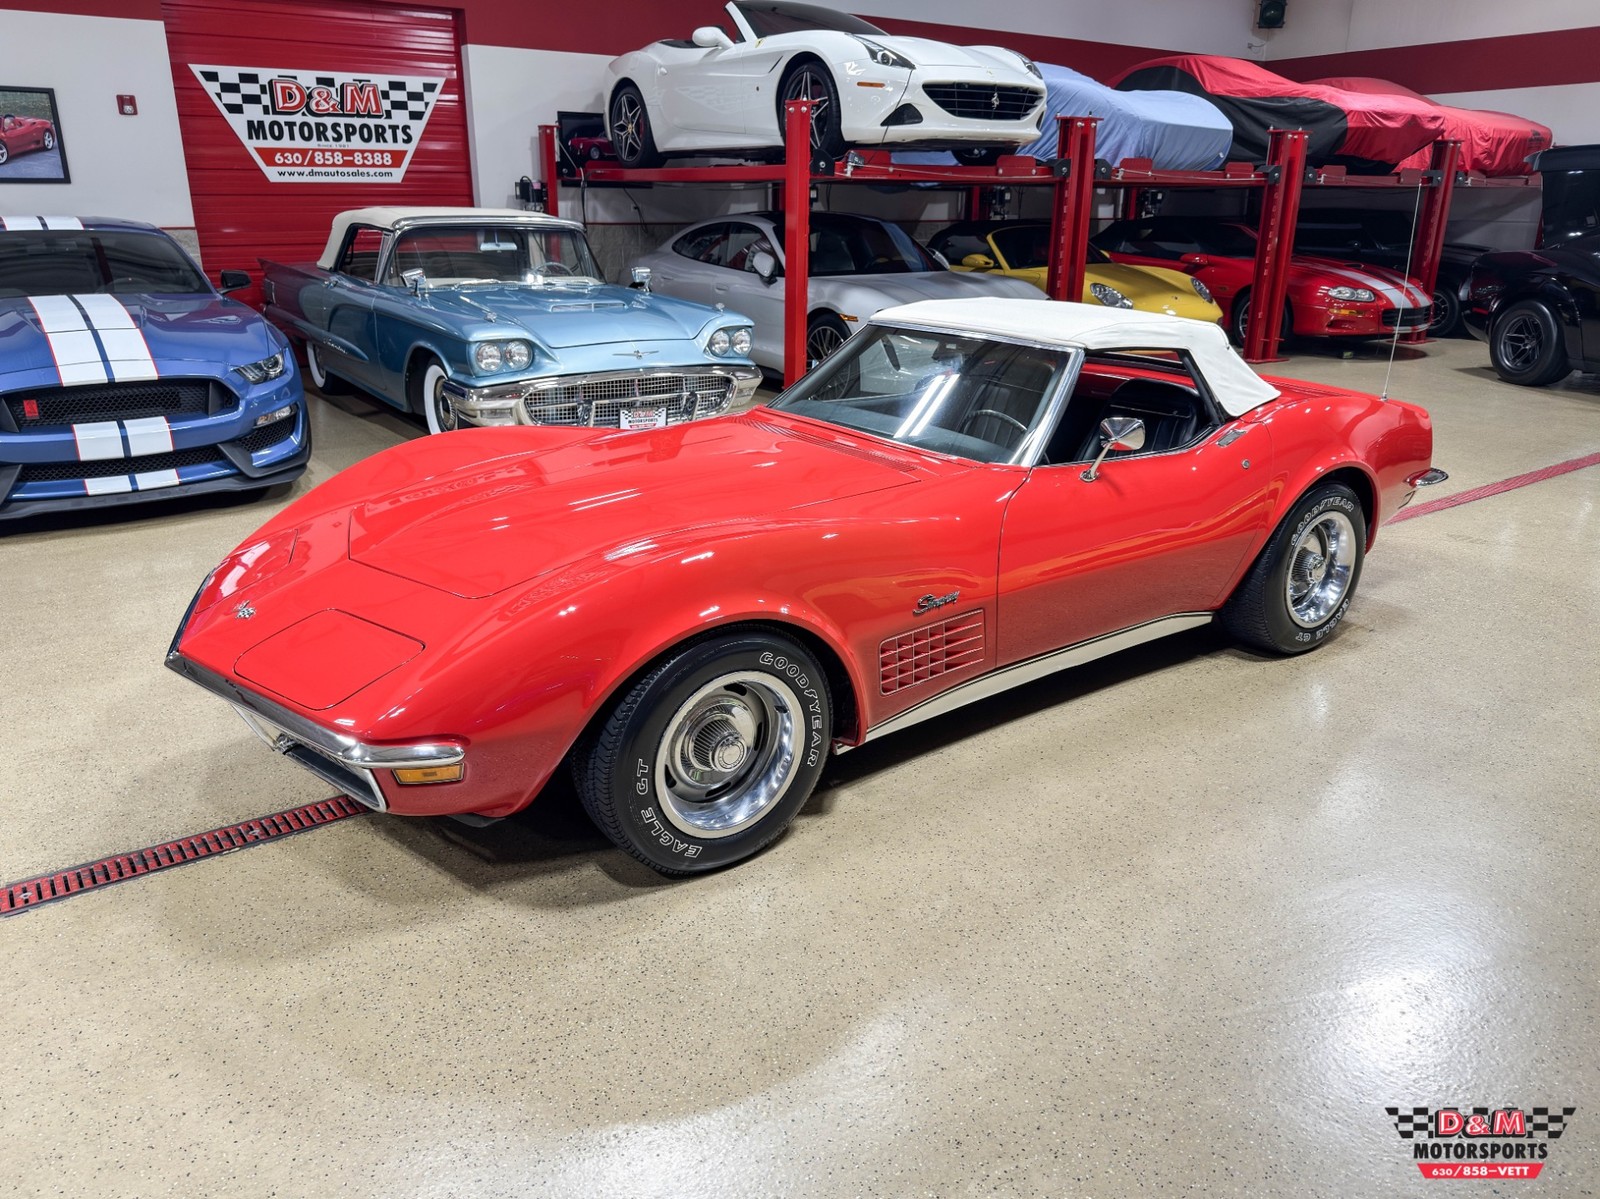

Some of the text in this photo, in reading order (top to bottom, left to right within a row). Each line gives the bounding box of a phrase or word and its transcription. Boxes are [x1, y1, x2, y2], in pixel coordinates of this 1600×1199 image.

[269, 78, 385, 119] D&M
[246, 120, 413, 144] MOTORSPORTS
[274, 150, 393, 166] 630/858-8388
[277, 168, 393, 178] www.dmautosales.com
[1291, 496, 1354, 546] GOODYEAR
[759, 651, 822, 767] GOODYEAR
[636, 758, 702, 858] EAGLE GT
